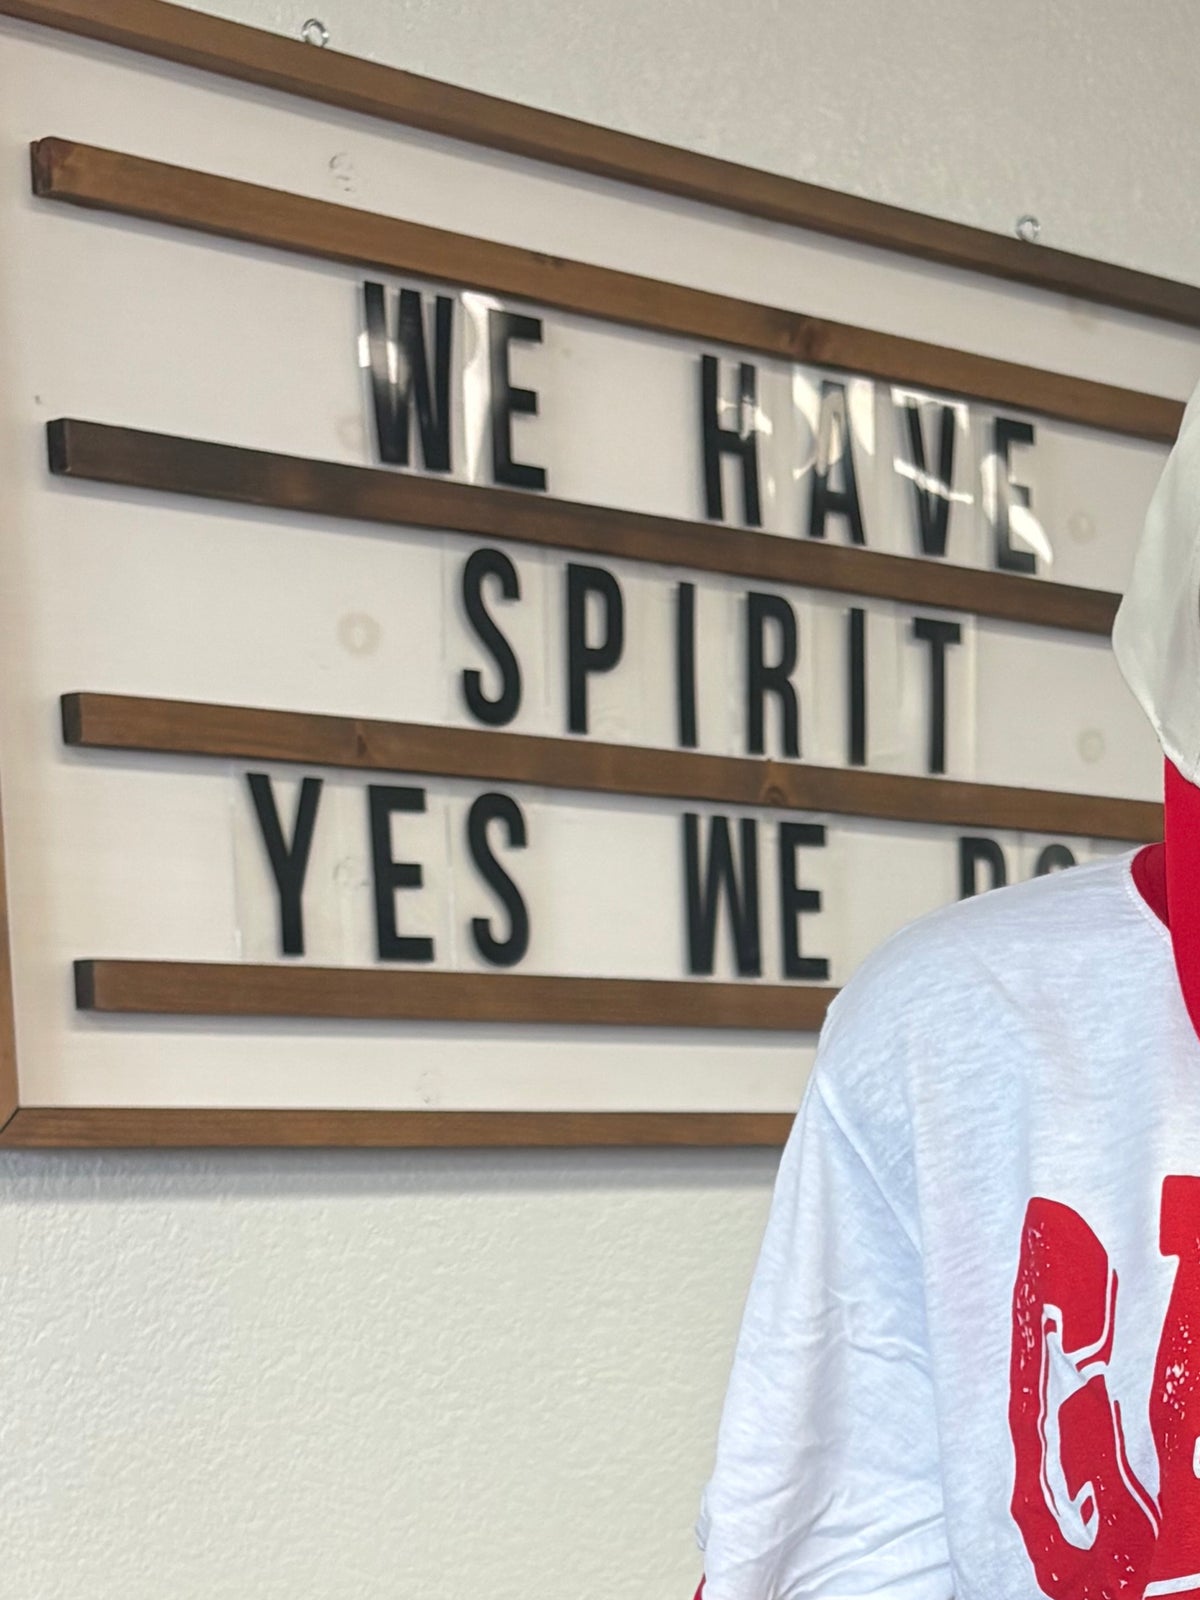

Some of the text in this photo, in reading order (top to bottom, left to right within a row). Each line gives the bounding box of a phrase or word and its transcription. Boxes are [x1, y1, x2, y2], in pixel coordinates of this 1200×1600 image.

[361, 280, 1038, 575] WE HAVE
[461, 548, 962, 774] SPIRIT
[246, 773, 831, 981] YES WE
